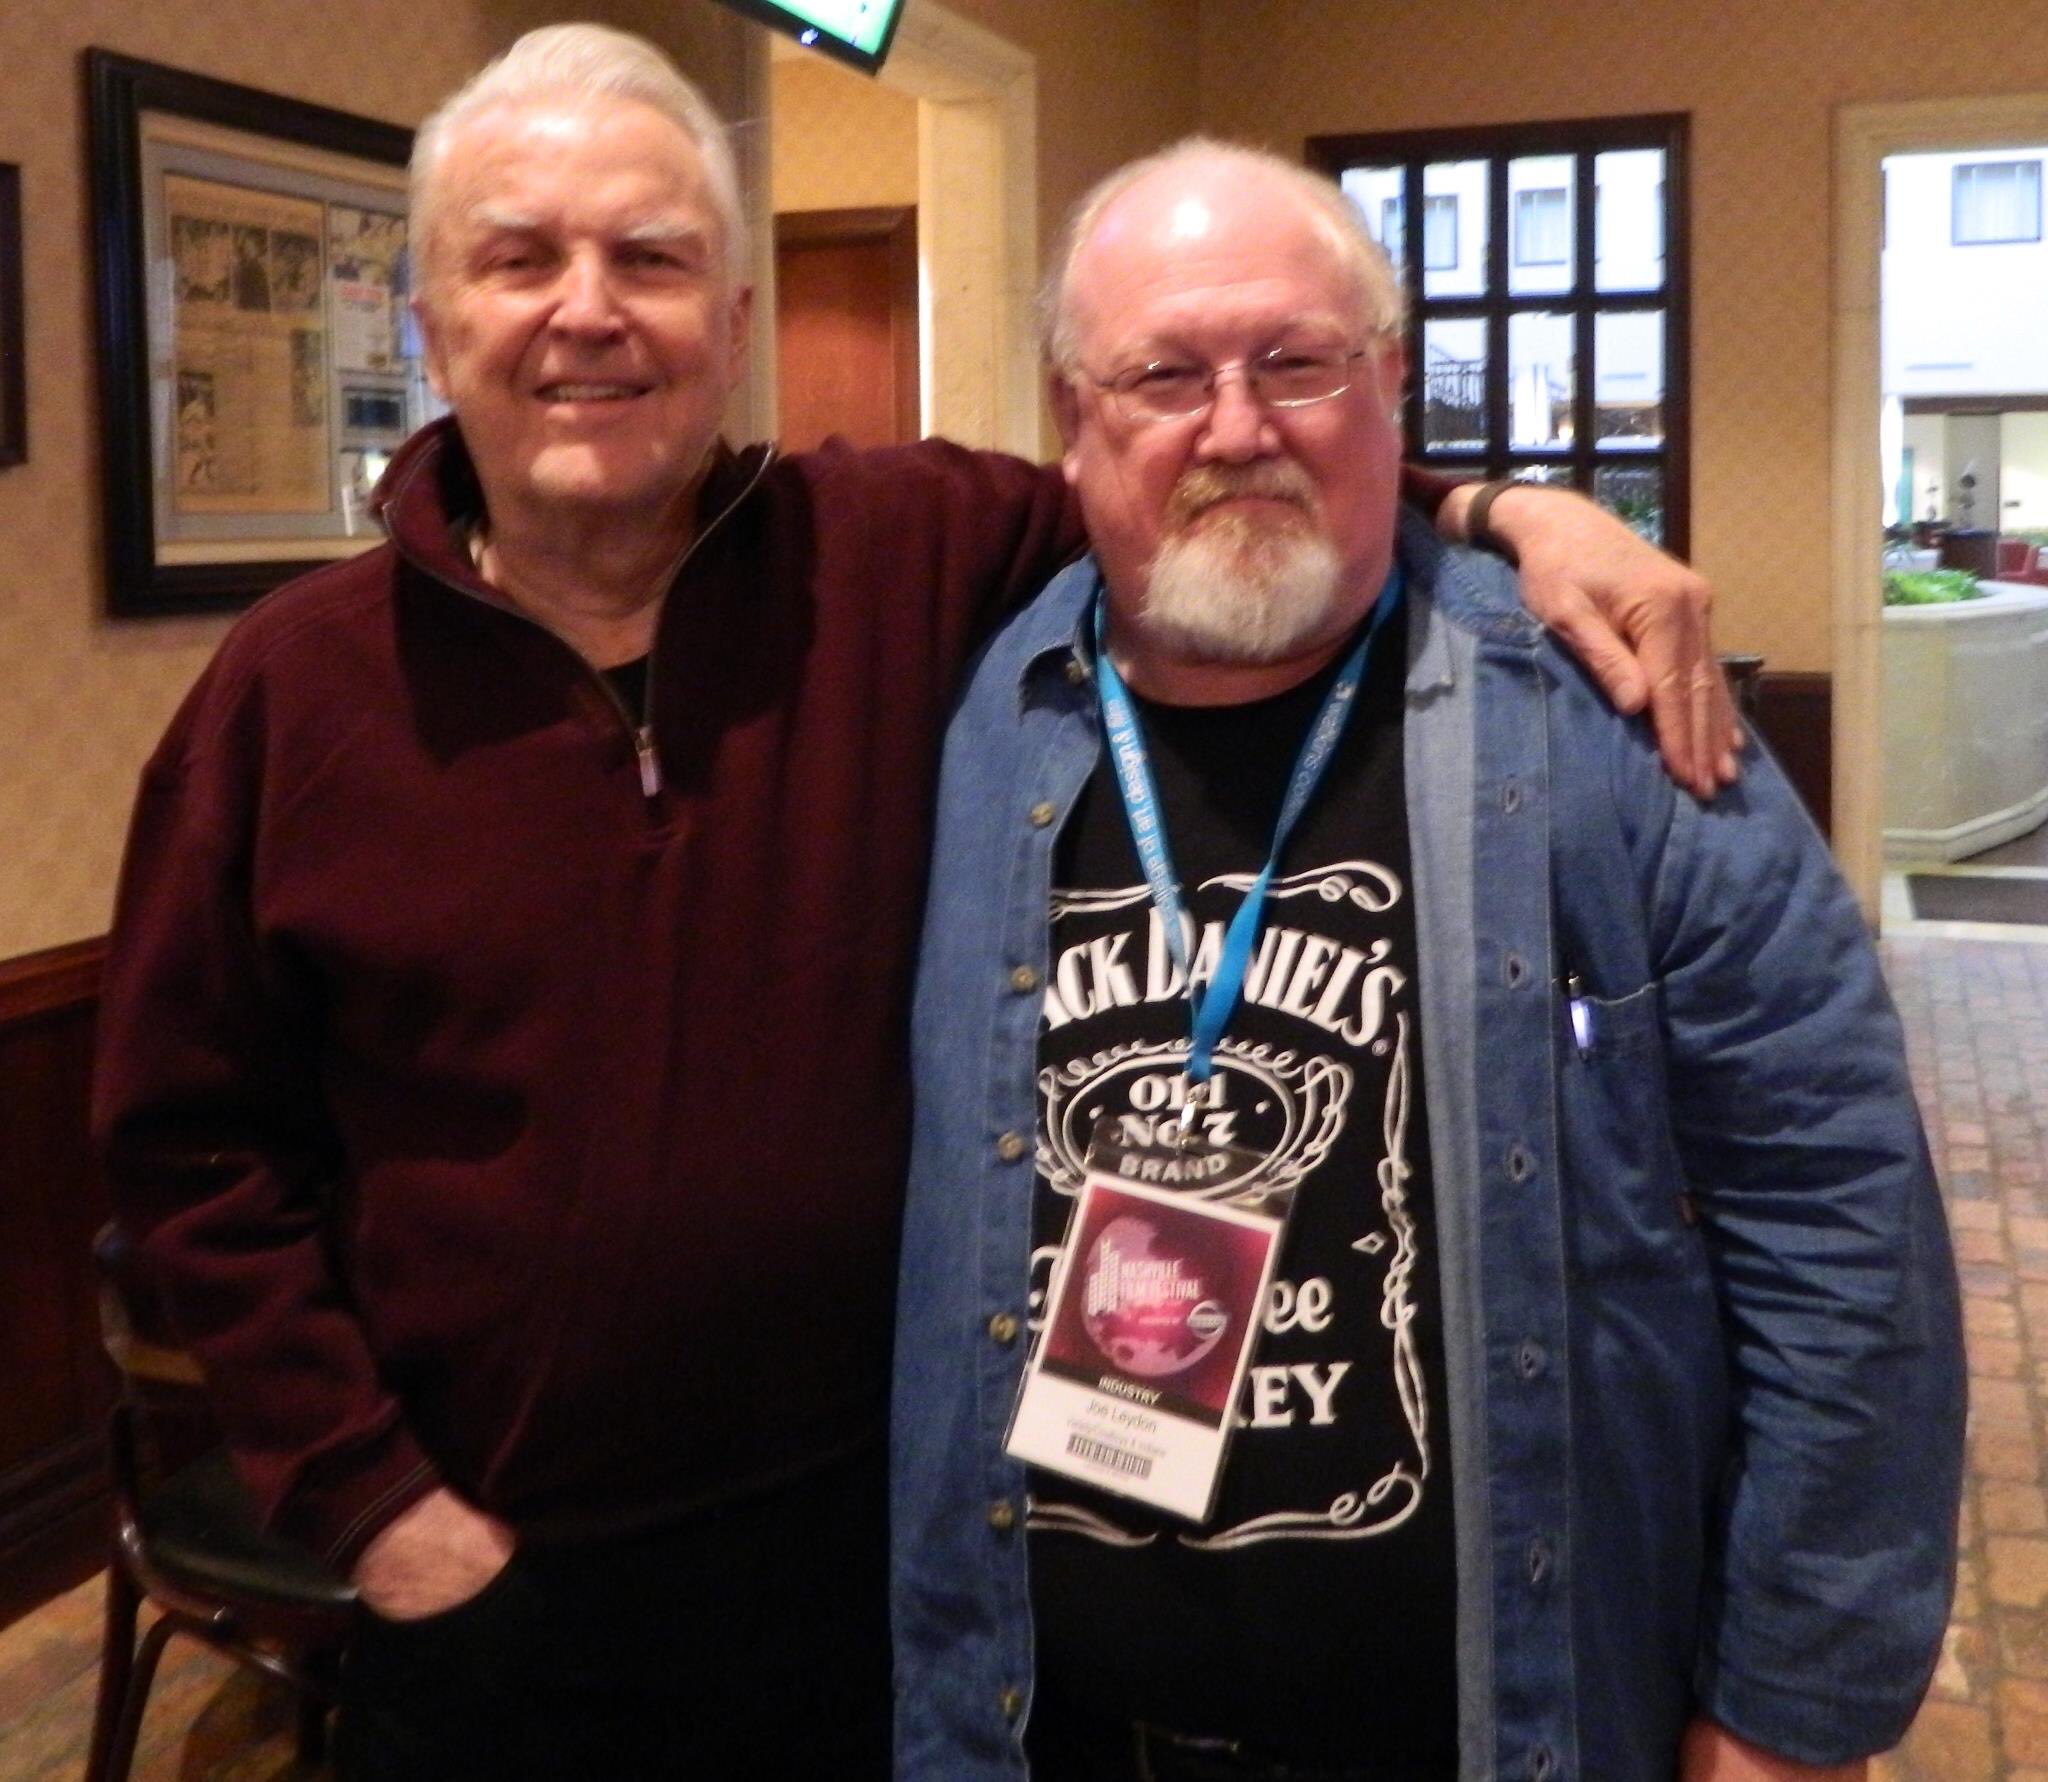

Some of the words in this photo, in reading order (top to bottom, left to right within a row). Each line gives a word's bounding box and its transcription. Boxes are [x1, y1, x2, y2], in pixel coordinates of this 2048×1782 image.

[1117, 1153, 1230, 1182] BRAND
[1099, 1376, 1162, 1406] INDUSTRY
[1087, 1399, 1109, 1416] Joe
[1111, 1408, 1158, 1434] Leydon
